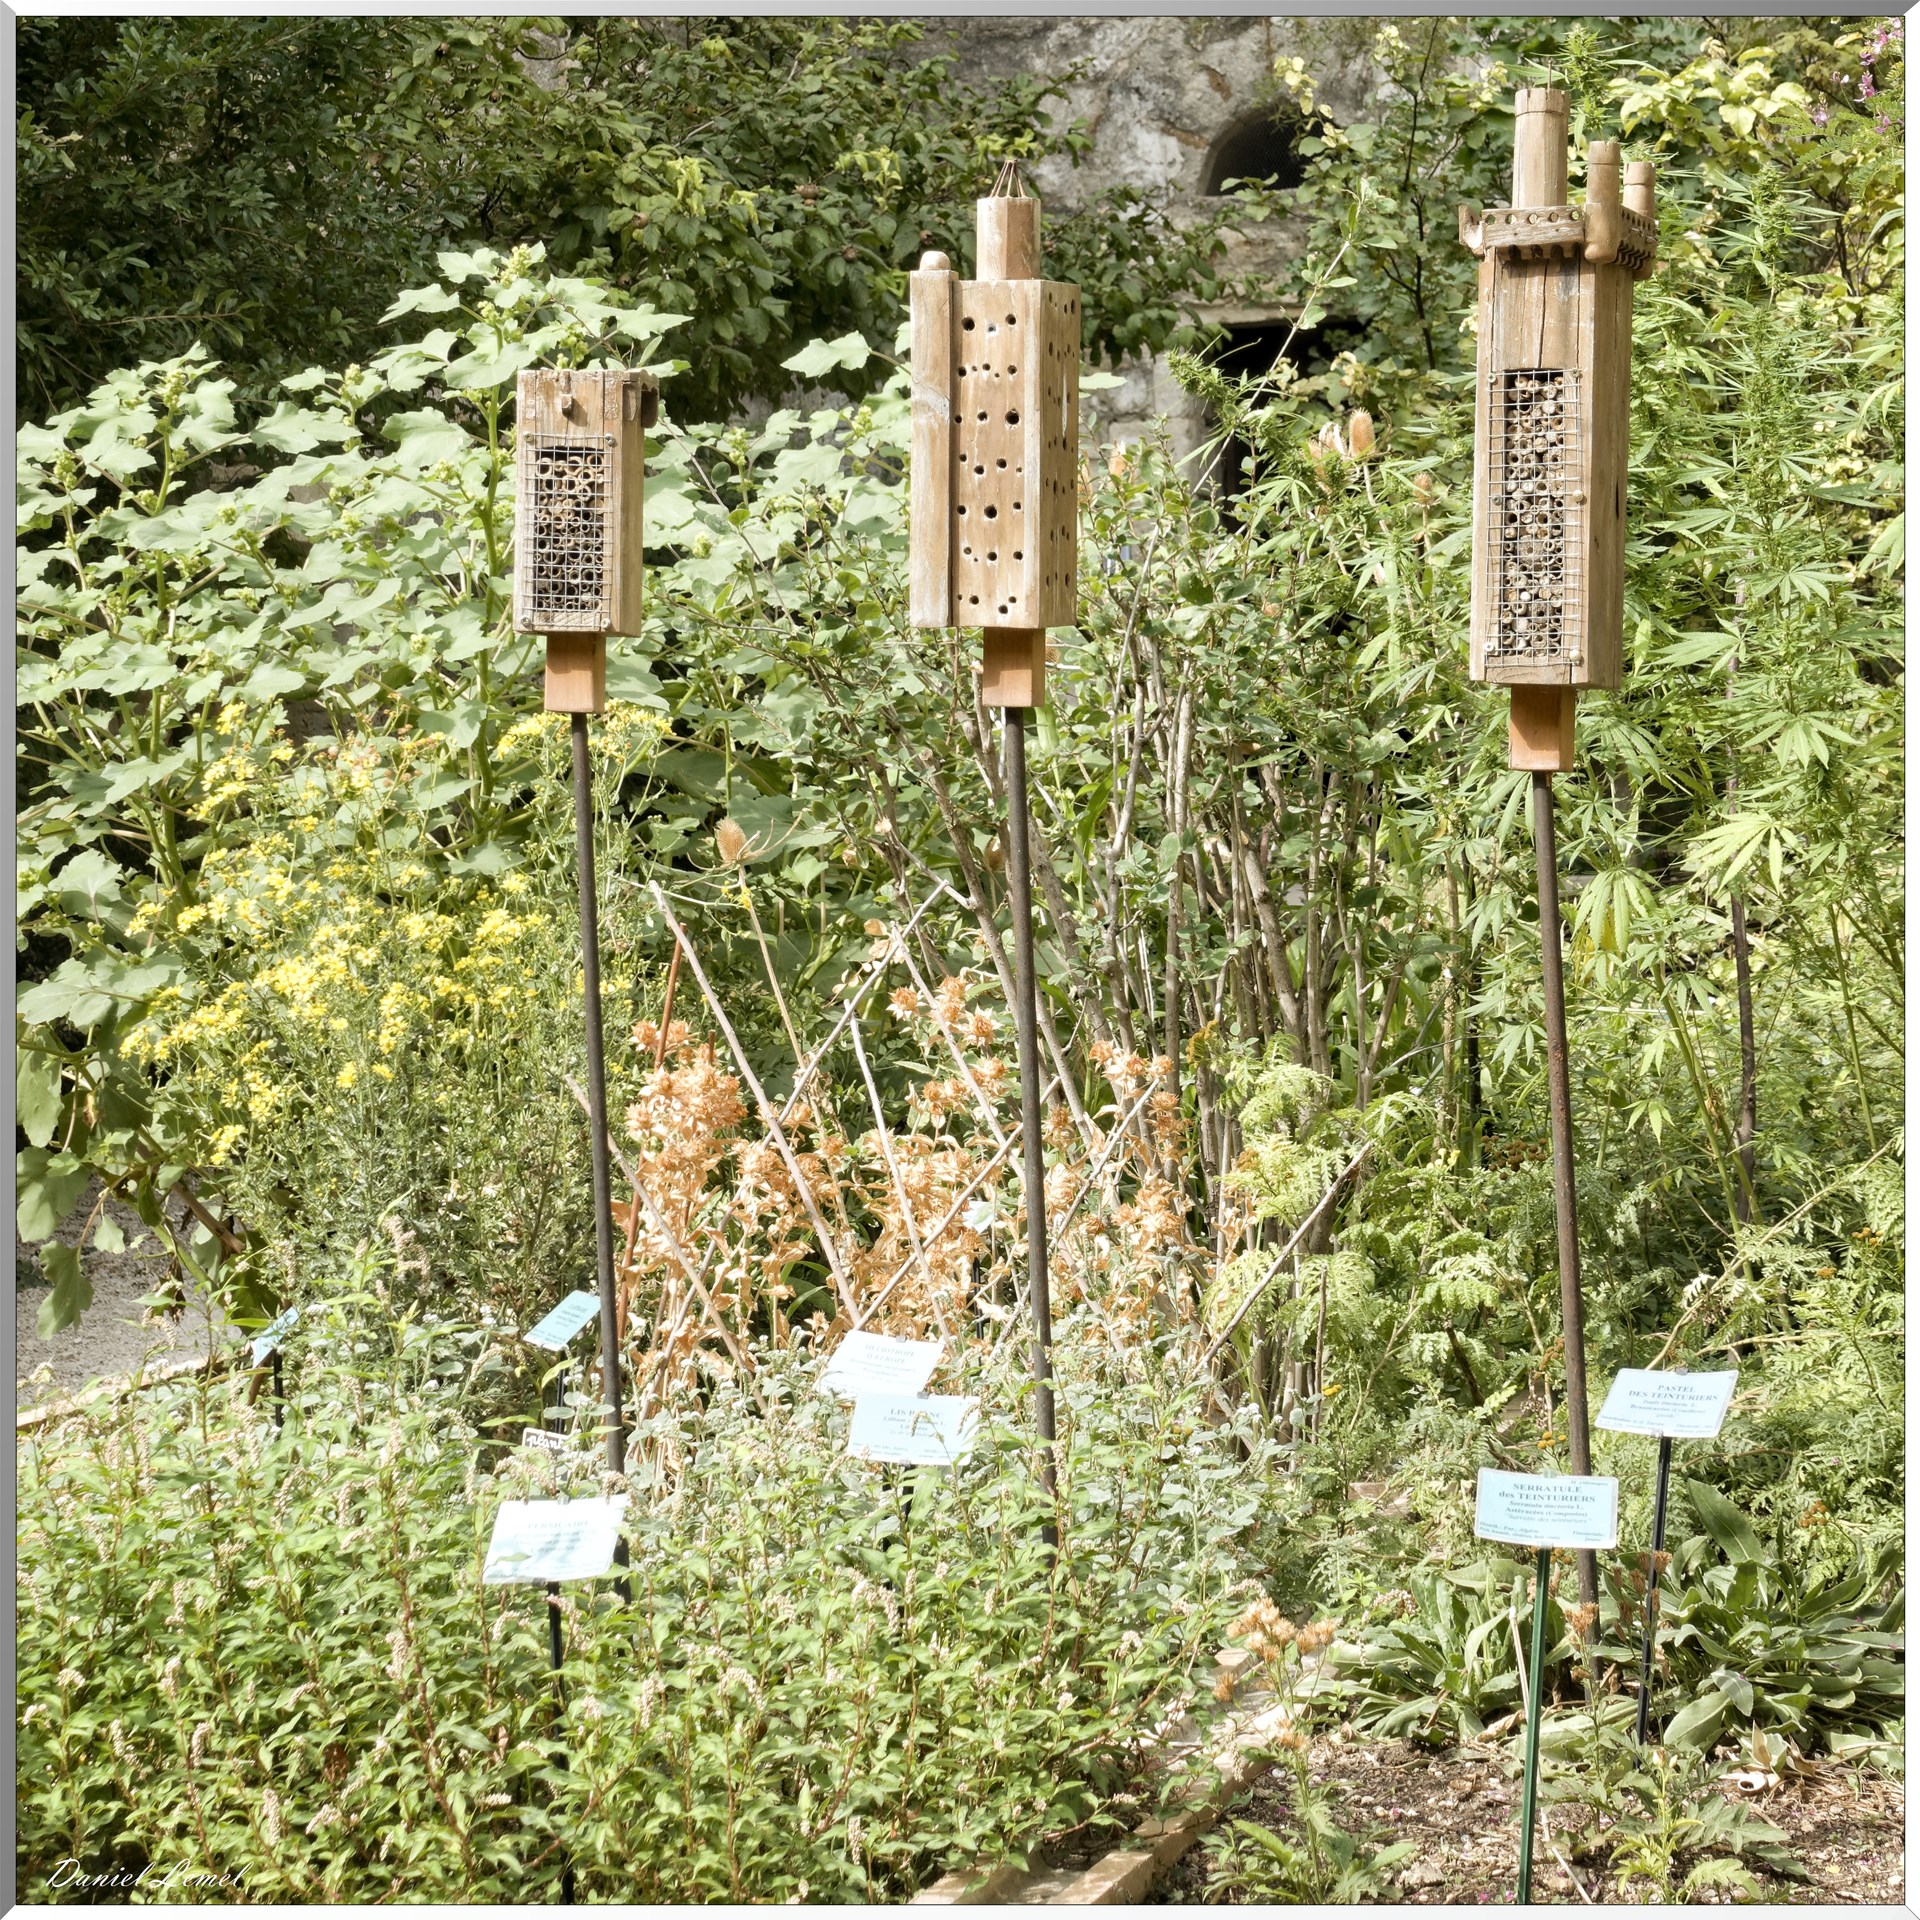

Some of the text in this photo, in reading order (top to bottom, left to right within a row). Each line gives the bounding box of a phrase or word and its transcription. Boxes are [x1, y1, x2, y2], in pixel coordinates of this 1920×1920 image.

[1657, 1384, 1696, 1393] PASTEL
[1651, 1392, 1719, 1401] TEINTURIERS
[890, 1408, 906, 1416] LIS
[1513, 1483, 1583, 1493] SERRATULE
[1499, 1491, 1596, 1503] des TEINTURIERS
[1508, 1500, 1543, 1509] Serratula
[1544, 1502, 1575, 1510] tinctoria
